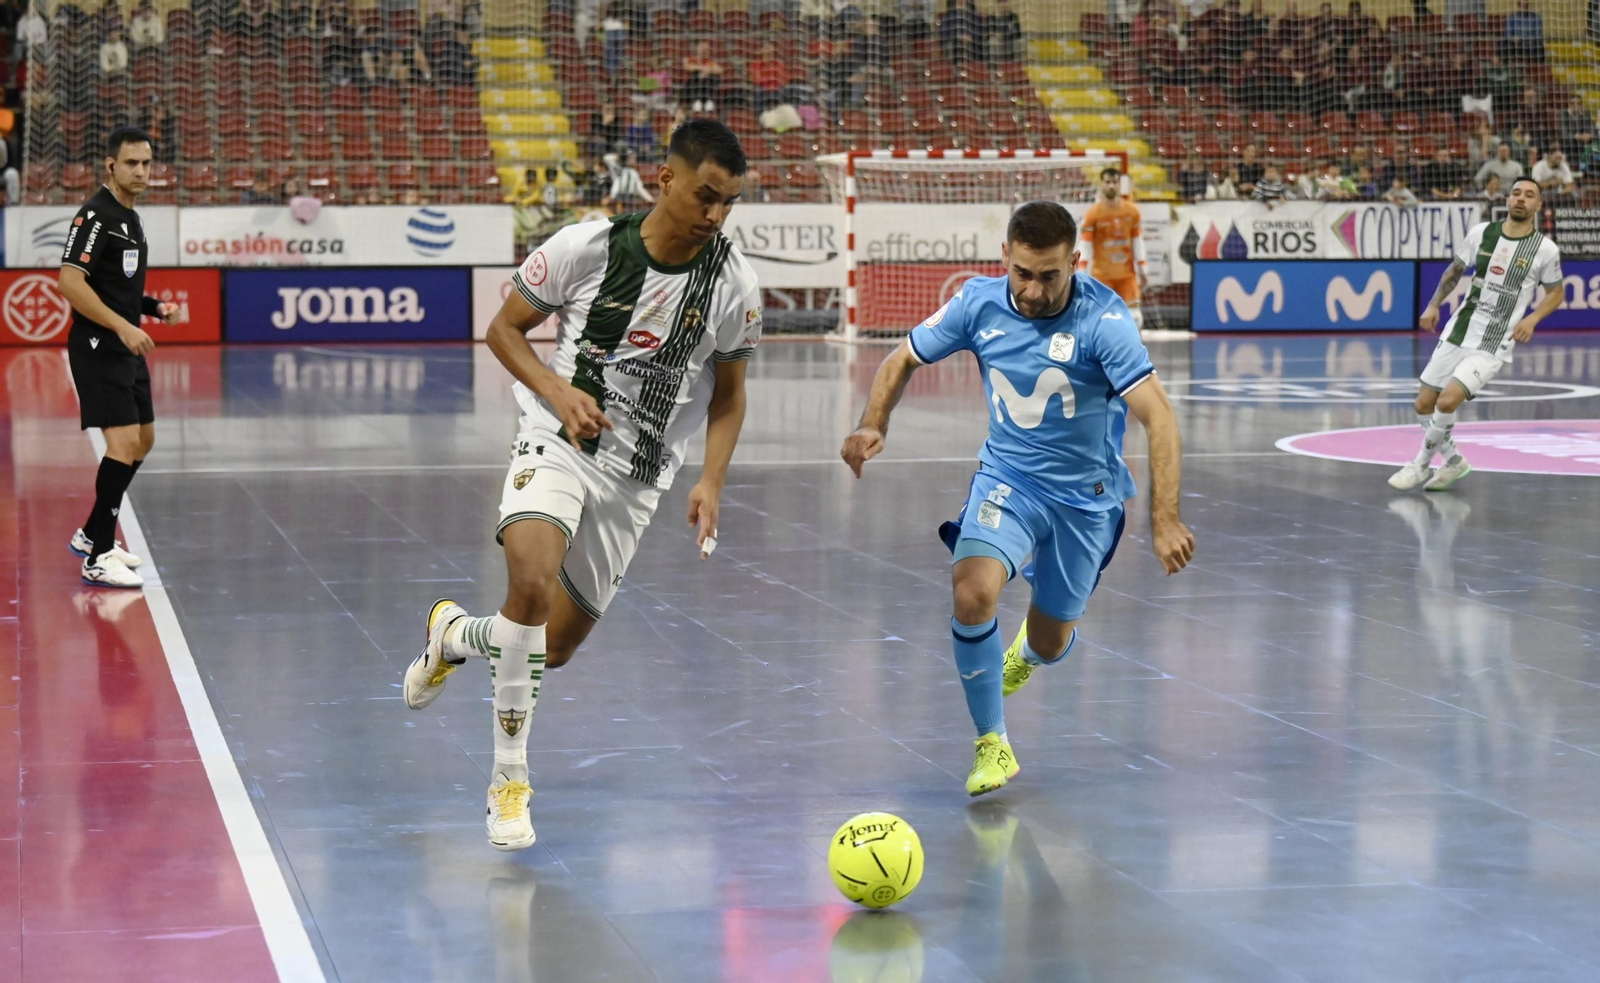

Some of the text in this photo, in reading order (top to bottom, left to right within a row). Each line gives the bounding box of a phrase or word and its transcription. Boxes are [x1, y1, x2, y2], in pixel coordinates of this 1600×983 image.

[731, 223, 837, 251] ASTER
[867, 233, 978, 260] efficold
[1253, 232, 1317, 253] RIOS
